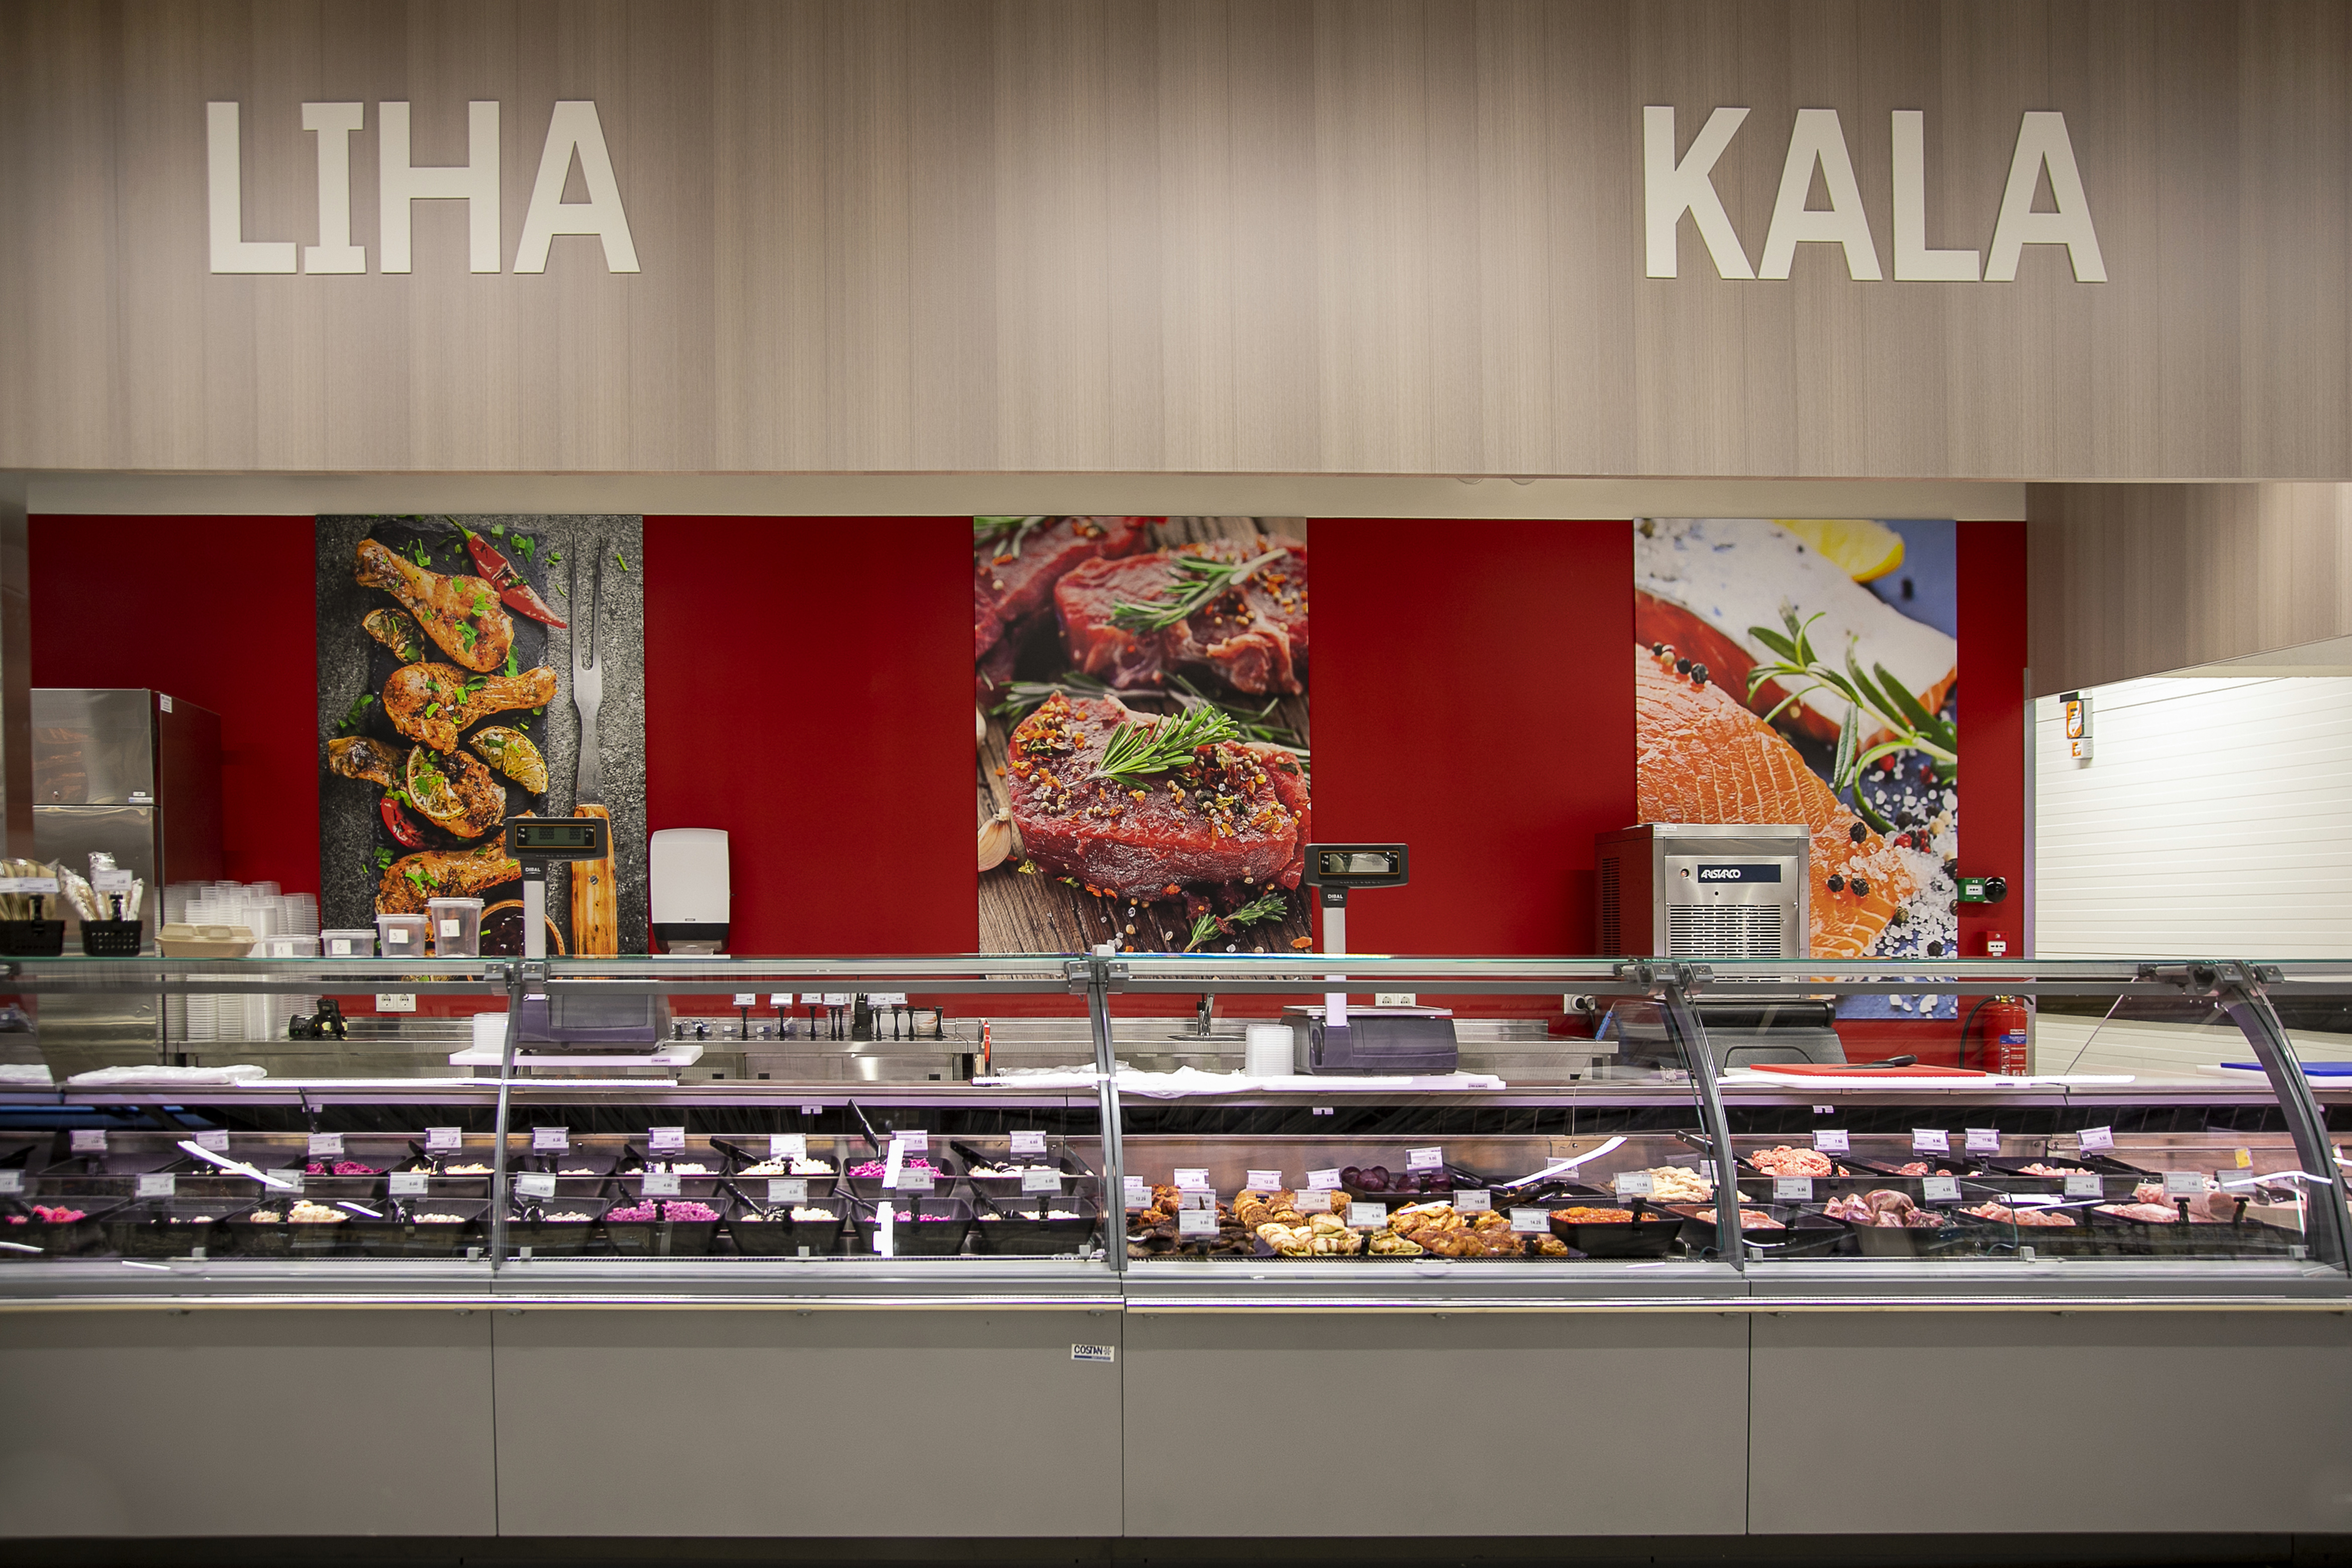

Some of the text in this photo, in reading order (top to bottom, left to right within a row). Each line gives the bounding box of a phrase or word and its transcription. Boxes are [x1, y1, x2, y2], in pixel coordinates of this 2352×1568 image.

[208, 101, 641, 274] LIHA
[1643, 106, 2108, 282] KALA
[1701, 869, 1741, 878] ARISTARCO
[445, 925, 449, 933] 4
[337, 942, 343, 951] 2
[1074, 1345, 1103, 1355] COSTAN
